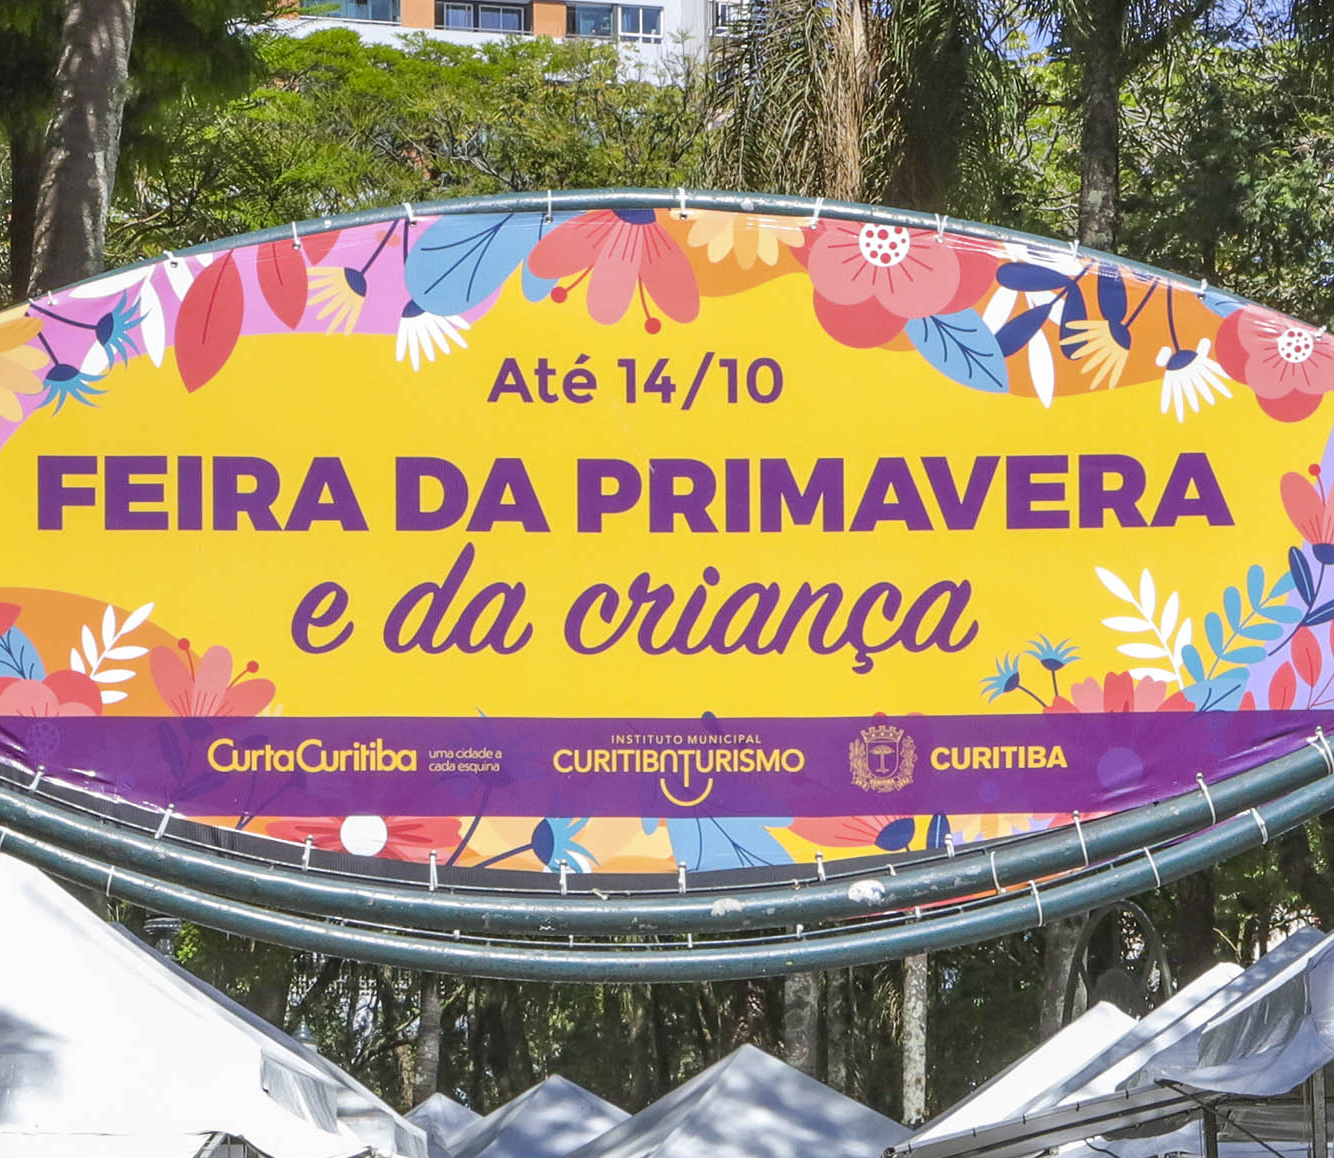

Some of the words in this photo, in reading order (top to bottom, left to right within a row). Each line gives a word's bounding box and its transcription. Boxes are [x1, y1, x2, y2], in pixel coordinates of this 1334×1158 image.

[488, 355, 596, 403] Até
[621, 354, 784, 409] 14/10
[37, 455, 366, 531] FEIRA
[398, 457, 548, 532] DA
[579, 453, 1233, 532] PRIMAVERA
[292, 582, 353, 655] e
[384, 544, 533, 655] da
[564, 566, 978, 675] criança
[611, 734, 684, 745] INSTITUTO
[687, 734, 762, 745] MUNICIPAL
[429, 749, 453, 759] uma
[455, 747, 493, 759] cidade
[494, 750, 503, 759] a
[930, 745, 1068, 771] CURITIBA
[429, 759, 456, 772] cada
[457, 760, 500, 774] esquina
